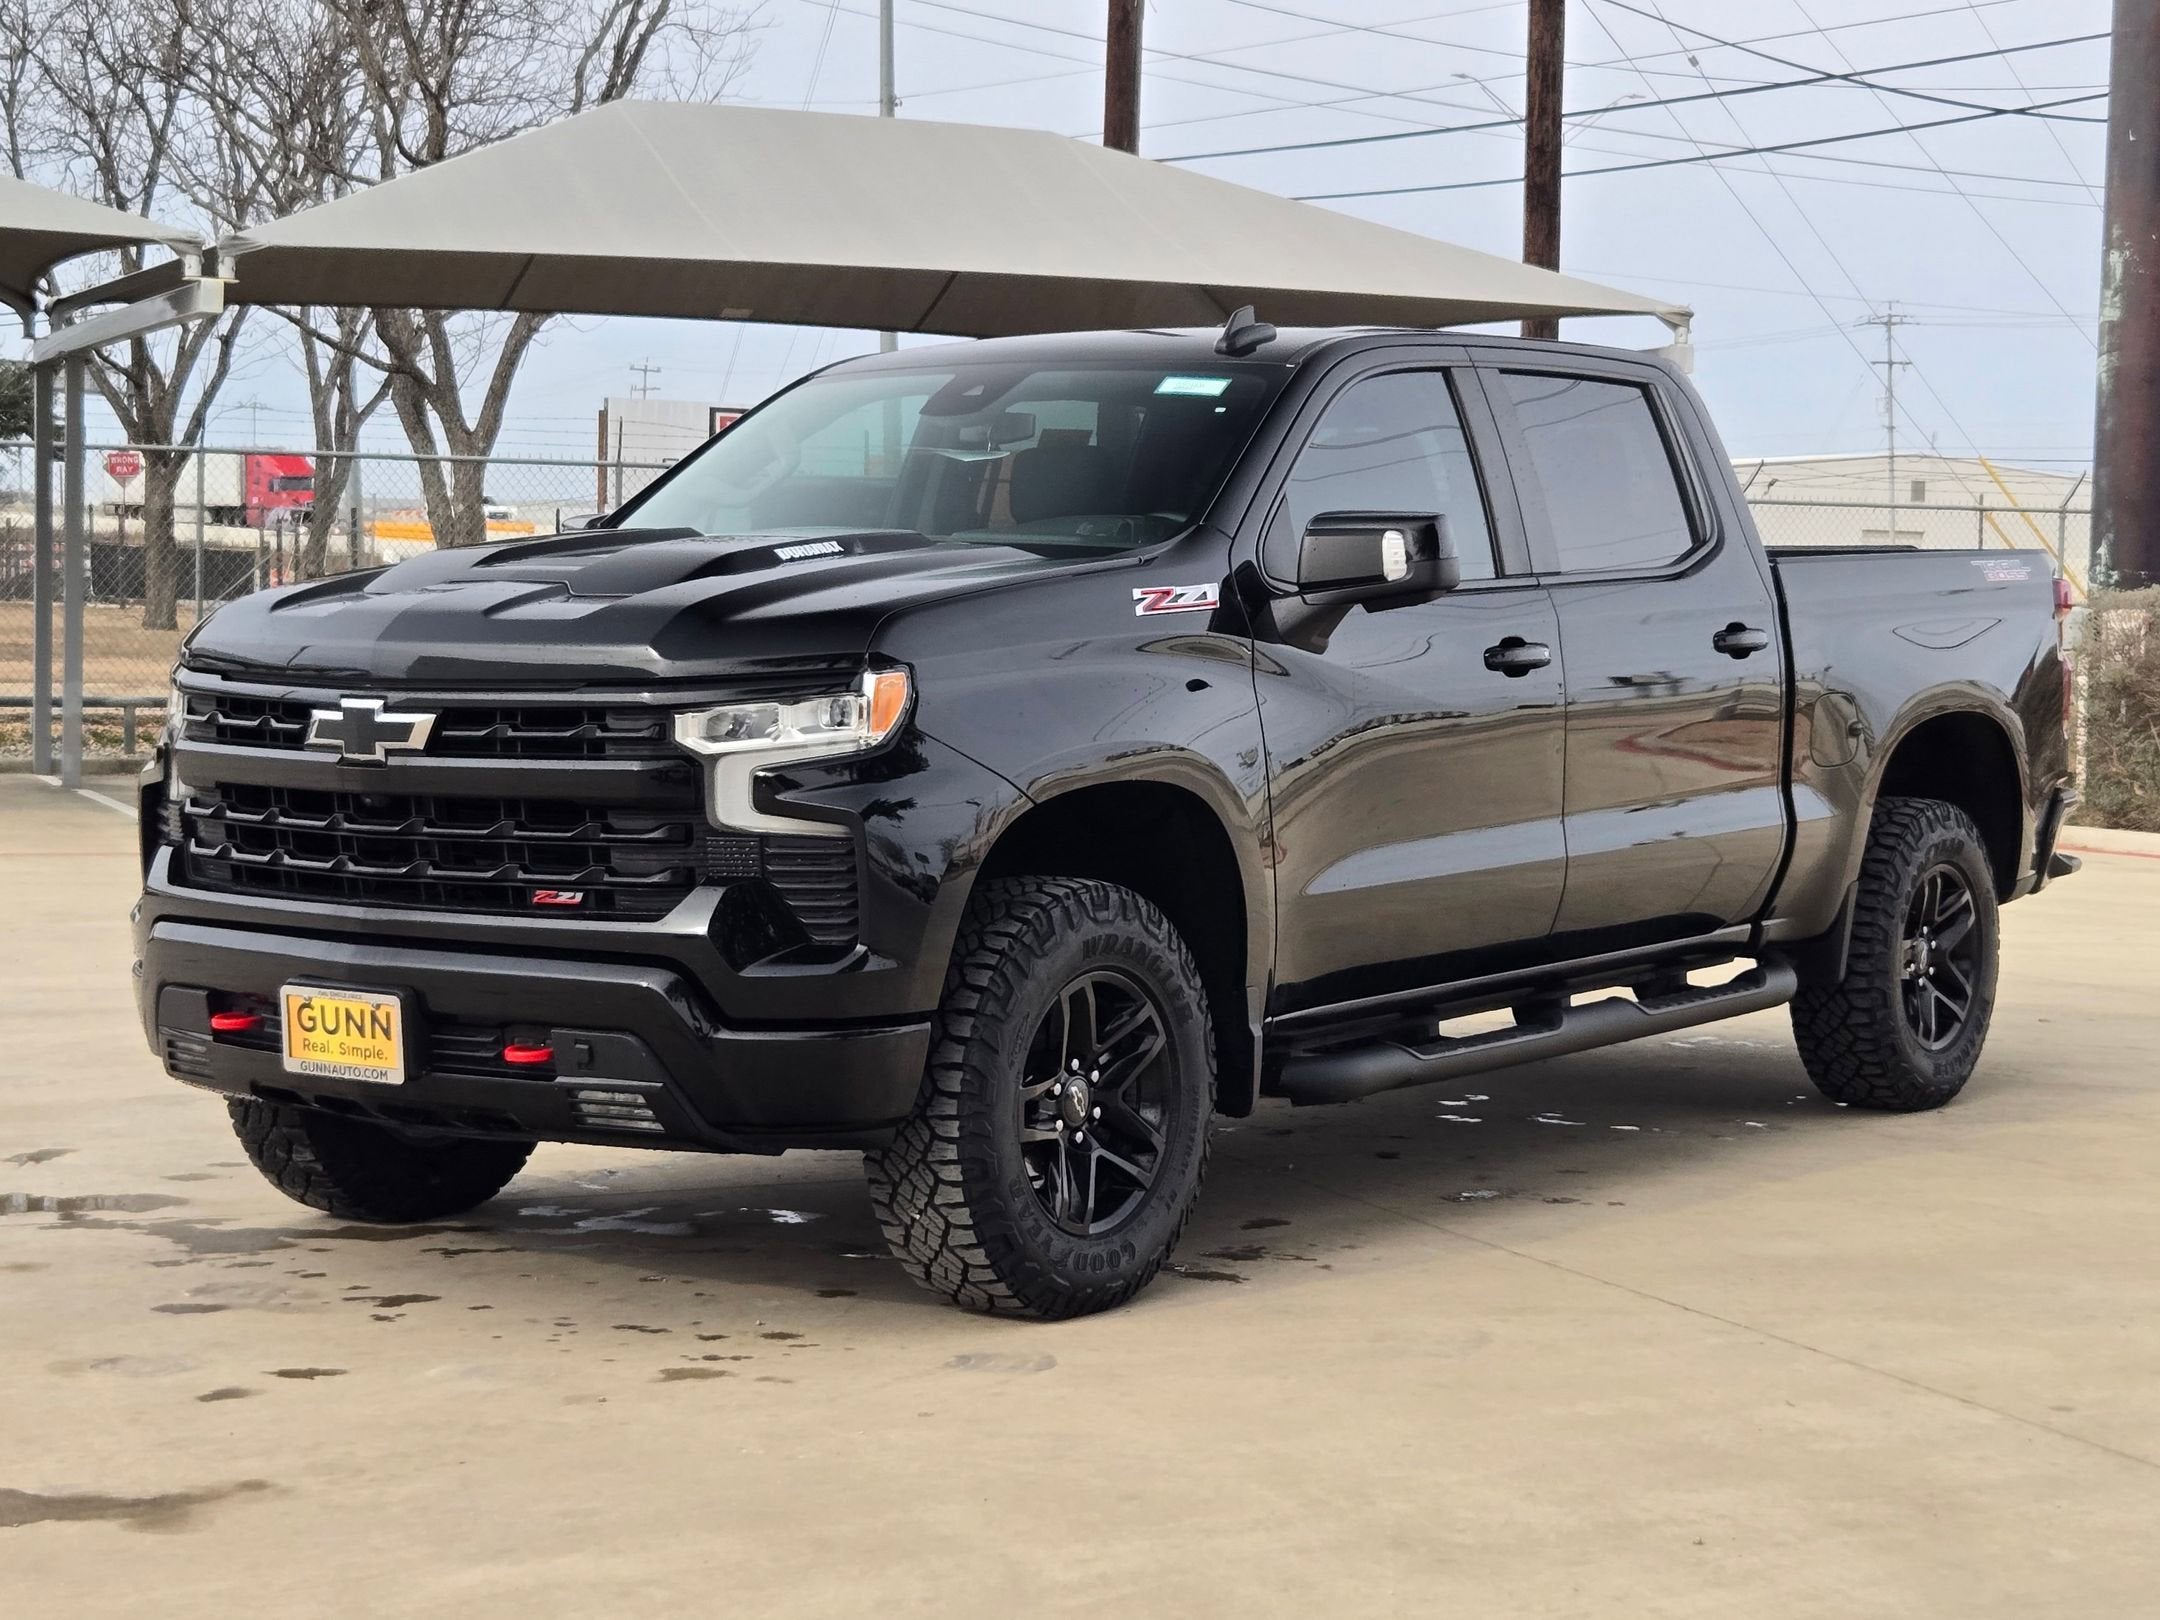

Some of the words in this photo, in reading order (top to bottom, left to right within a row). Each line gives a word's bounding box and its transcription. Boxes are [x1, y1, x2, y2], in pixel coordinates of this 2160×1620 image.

[110, 455, 139, 465] WRONG
[773, 541, 845, 560] DURAMAX
[1132, 582, 1219, 616] Z71
[533, 889, 584, 905] Z71
[297, 1002, 392, 1041] GUNN
[303, 1037, 335, 1055] Real.
[339, 1041, 389, 1061] Simple.
[300, 1060, 390, 1081] GUNNAUTO.COM
